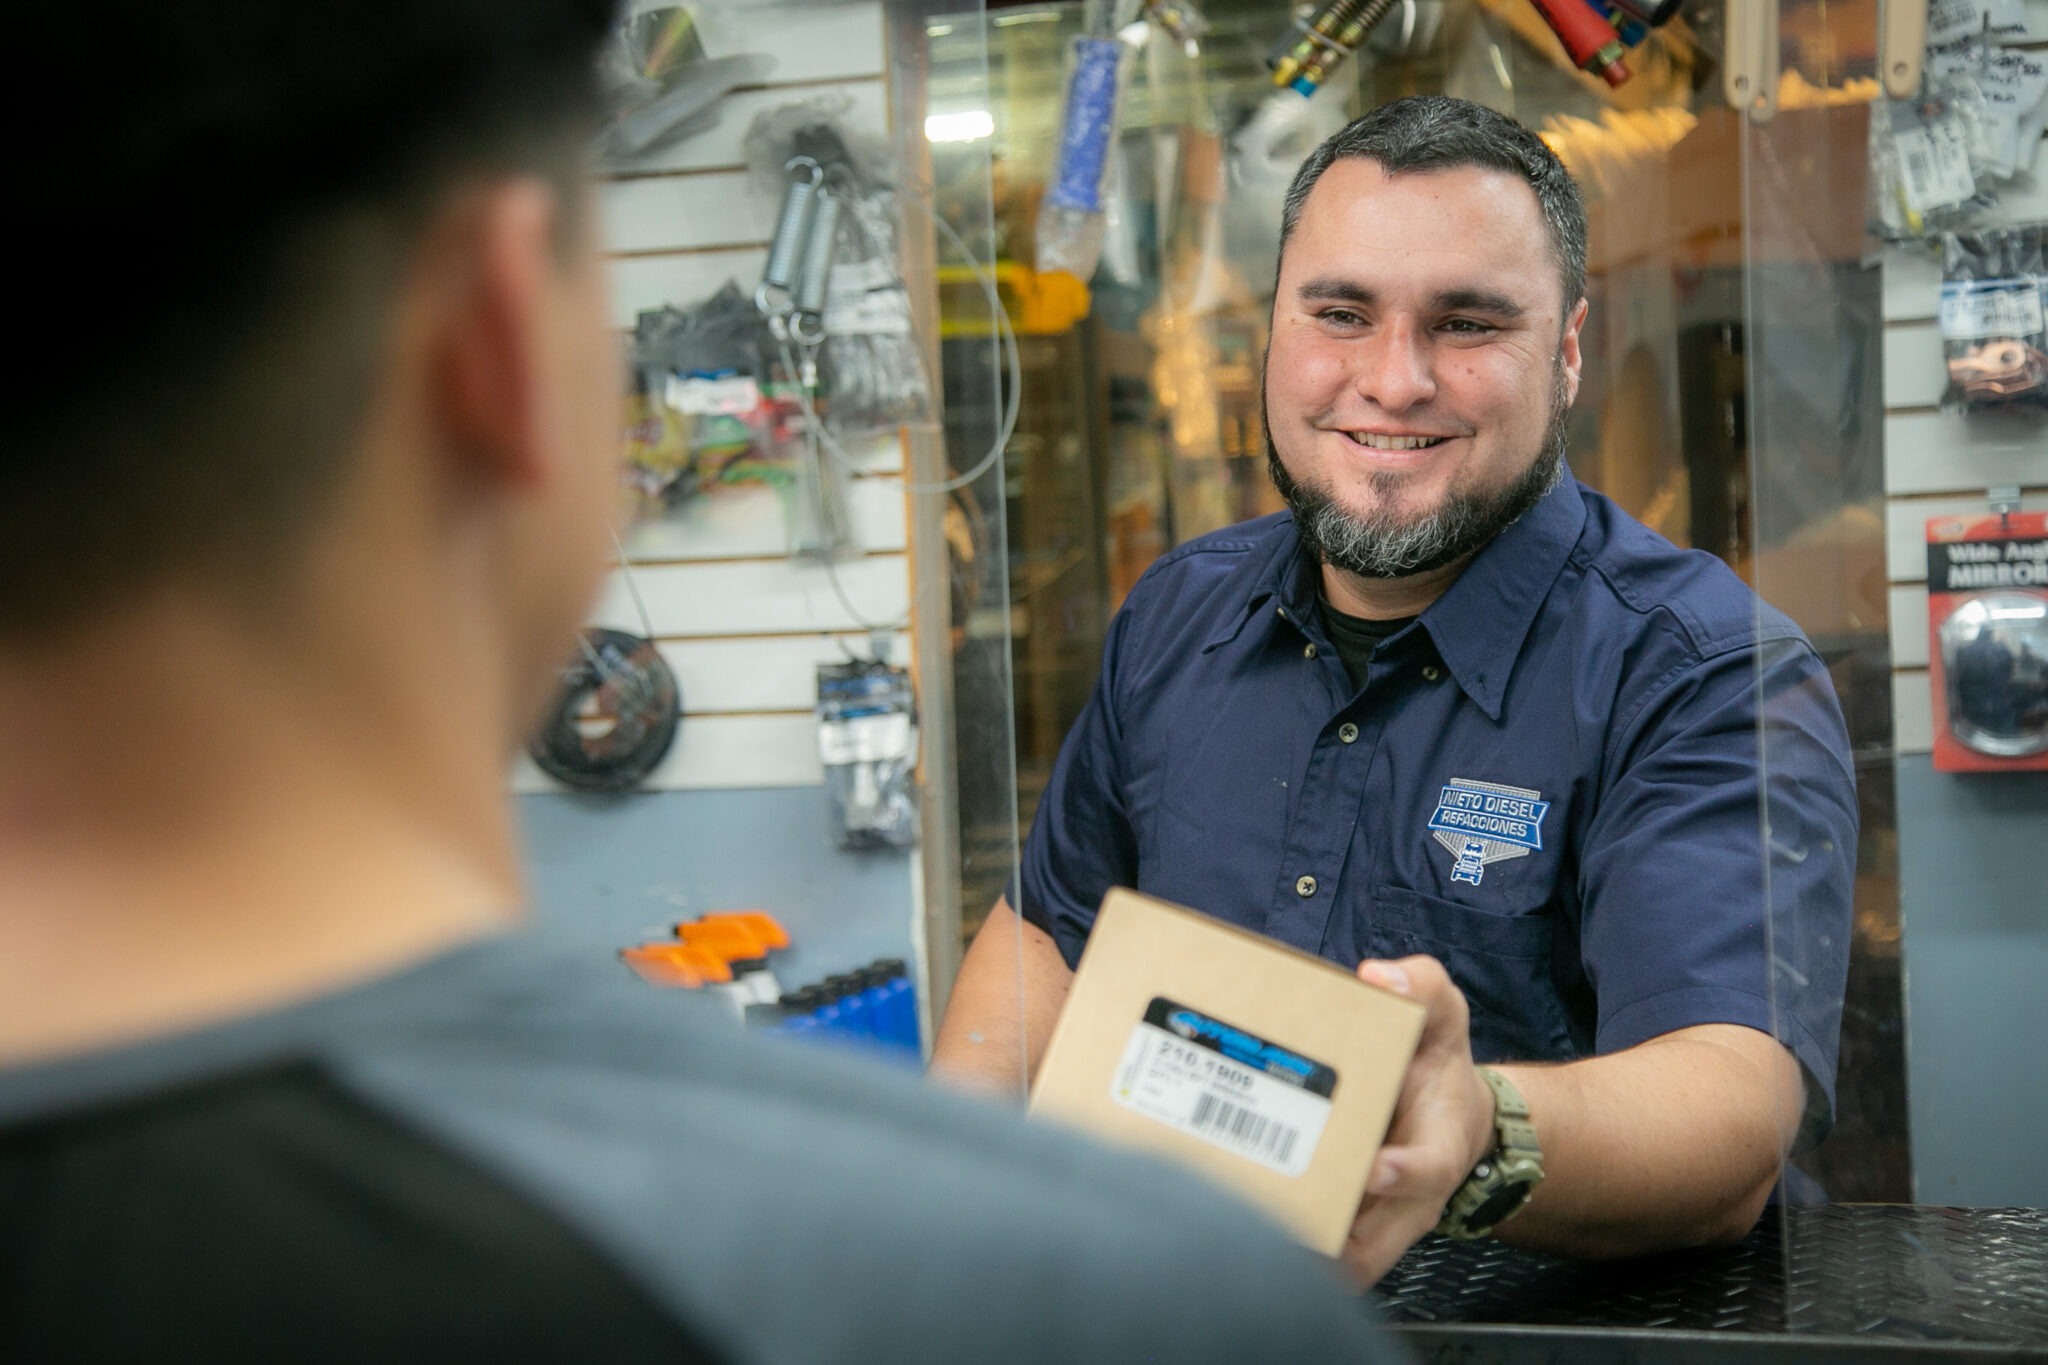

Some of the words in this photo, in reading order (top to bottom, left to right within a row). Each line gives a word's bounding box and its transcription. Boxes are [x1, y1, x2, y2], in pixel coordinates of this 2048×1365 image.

[1949, 542, 2001, 563] Wide
[1442, 790, 1483, 809] NIETO
[1485, 797, 1537, 820] DIESEL
[1441, 810, 1527, 837] REFACCIONES
